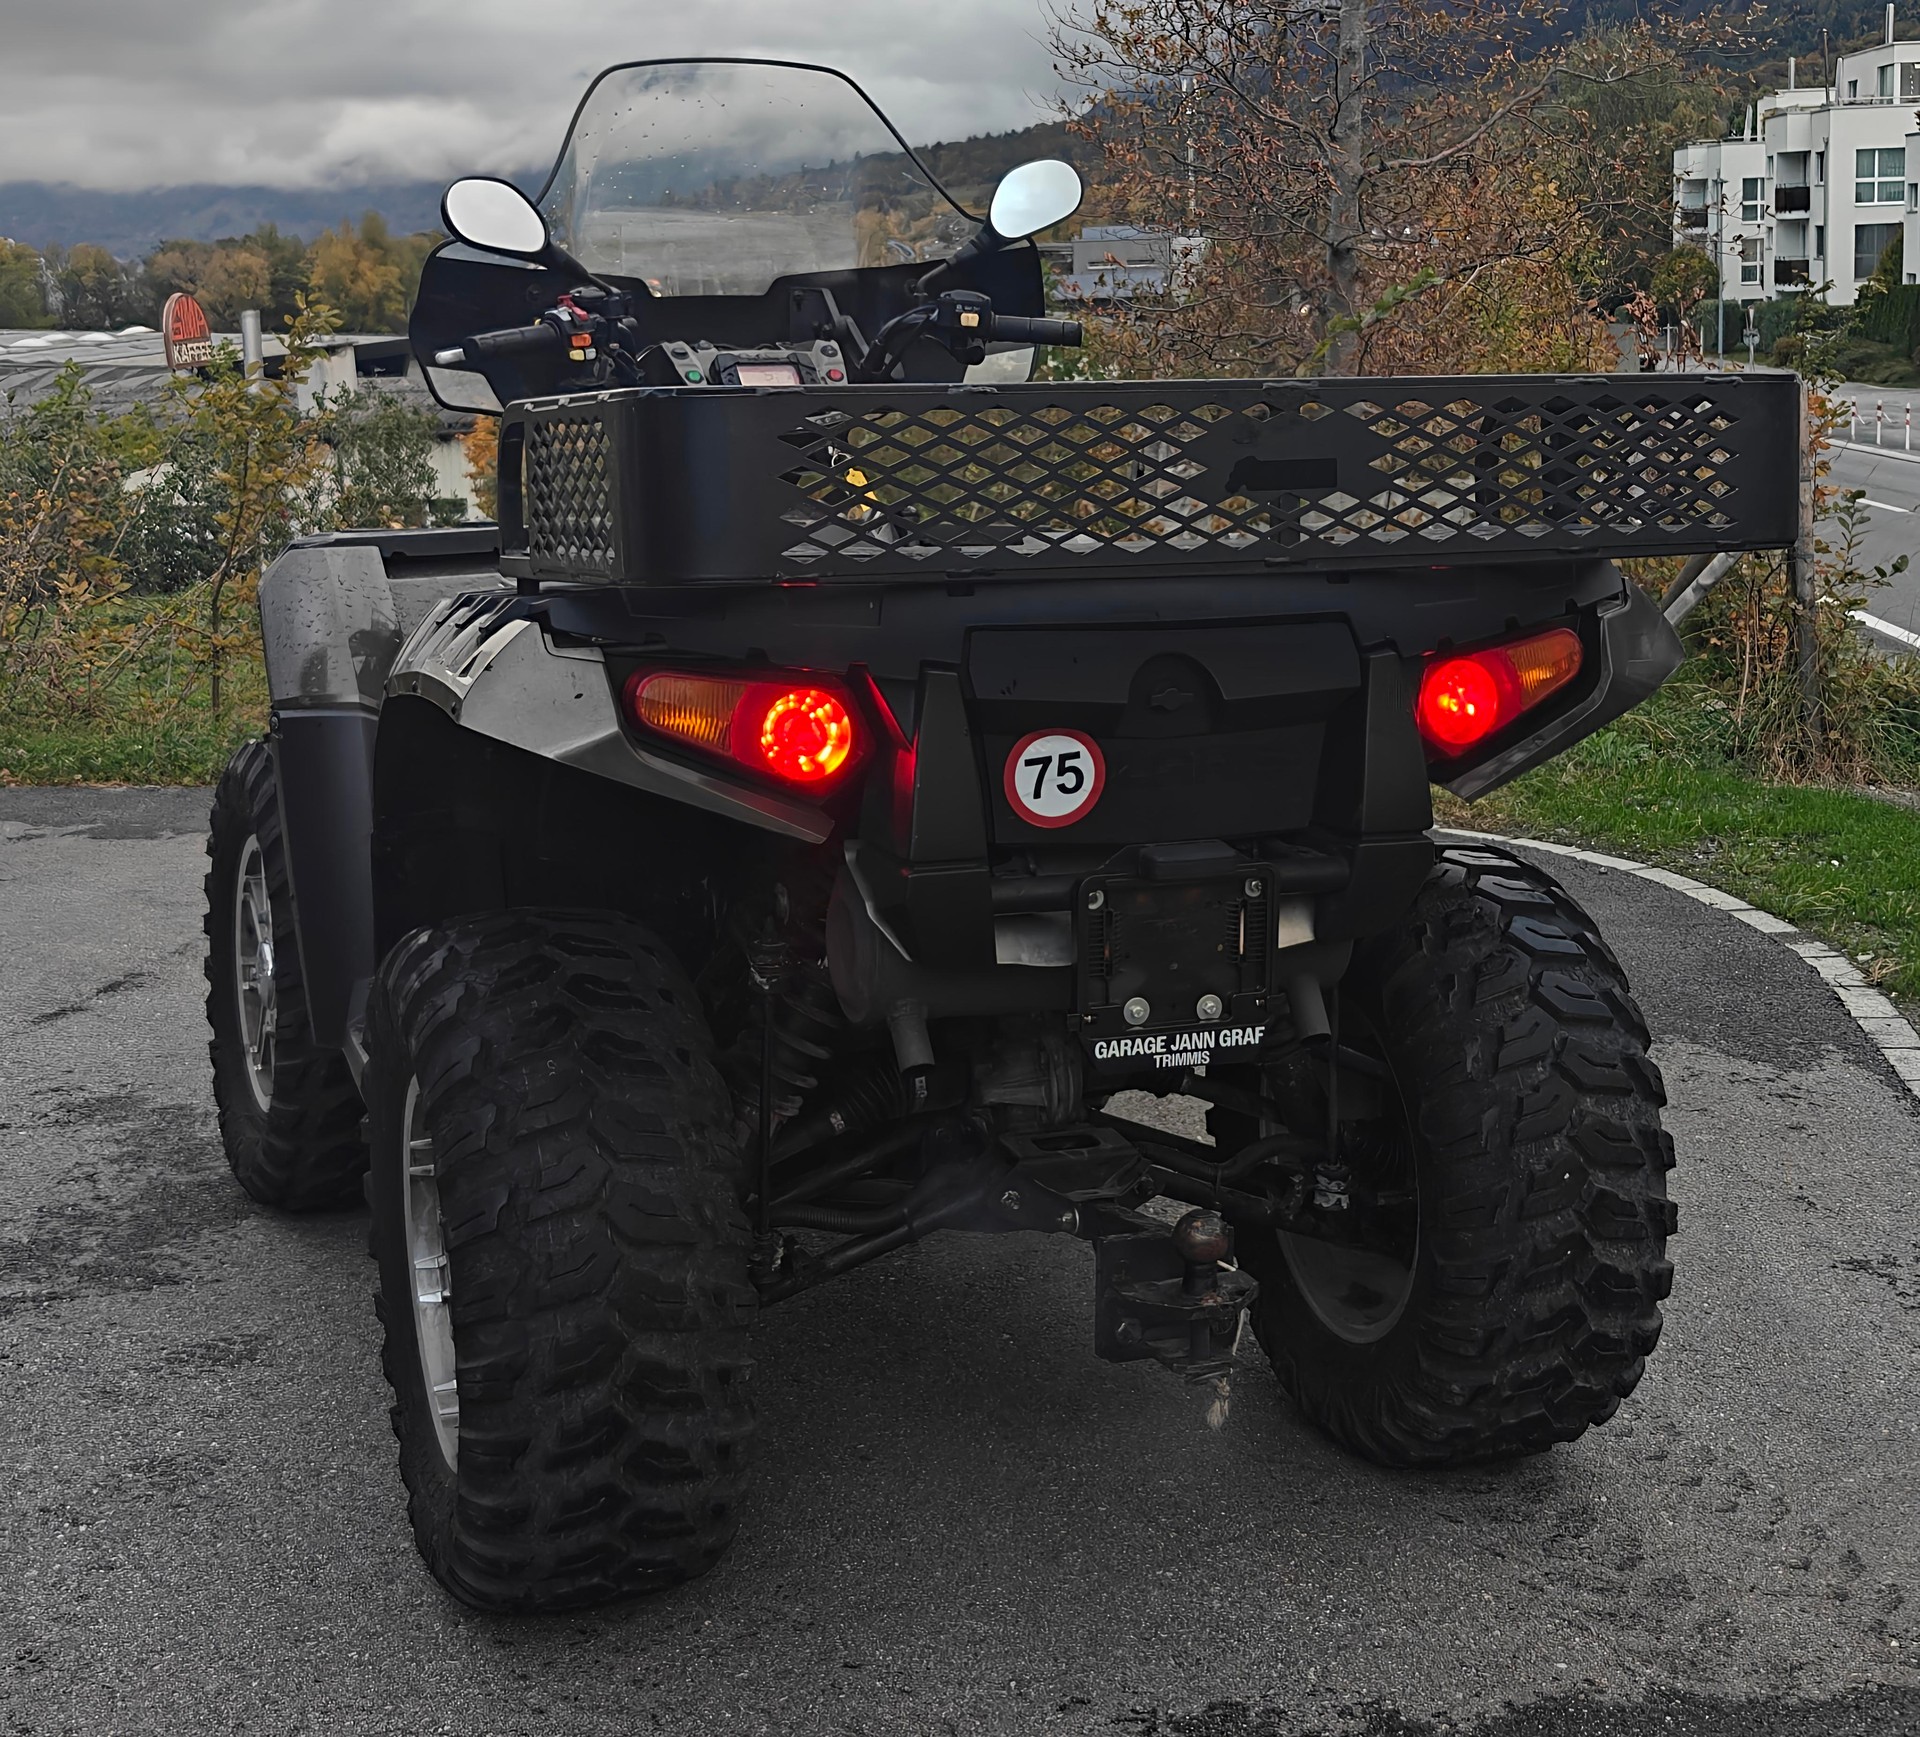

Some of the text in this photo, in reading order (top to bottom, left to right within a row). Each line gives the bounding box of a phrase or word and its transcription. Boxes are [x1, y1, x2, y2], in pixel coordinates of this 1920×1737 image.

[1024, 750, 1085, 800] 75
[1094, 1026, 1266, 1059] GARAGE JANN GRAF
[1153, 1050, 1211, 1069] TRIMMIS
